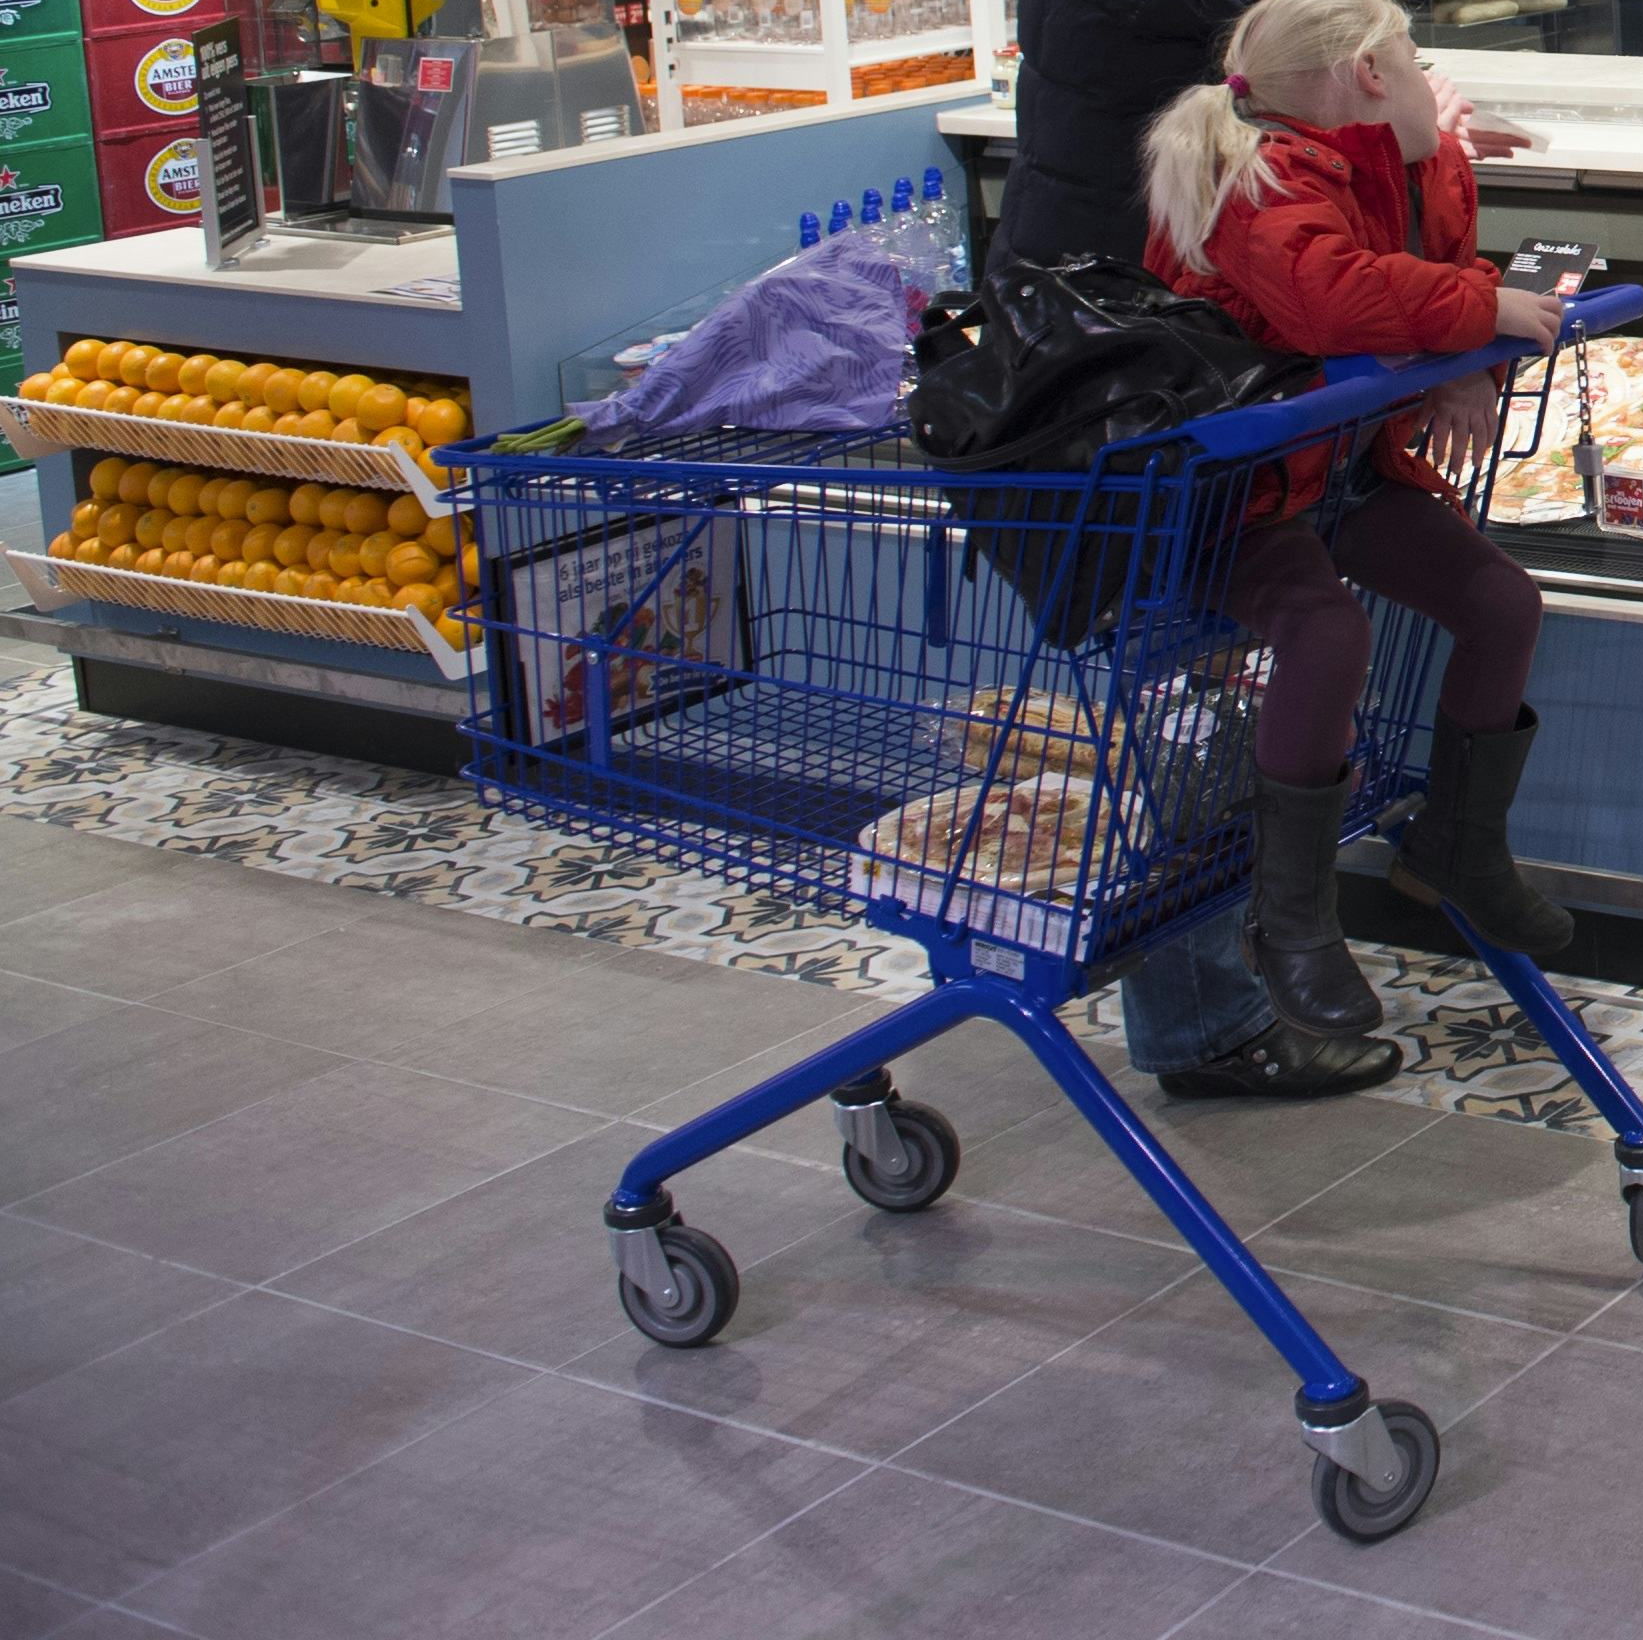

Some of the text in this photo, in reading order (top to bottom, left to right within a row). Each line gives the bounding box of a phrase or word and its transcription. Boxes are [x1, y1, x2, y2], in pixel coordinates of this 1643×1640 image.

[152, 64, 196, 81] AMSTE
[165, 79, 193, 91] BIER
[162, 167, 198, 181] AMST
[559, 564, 569, 581] 6
[559, 582, 582, 603] als
